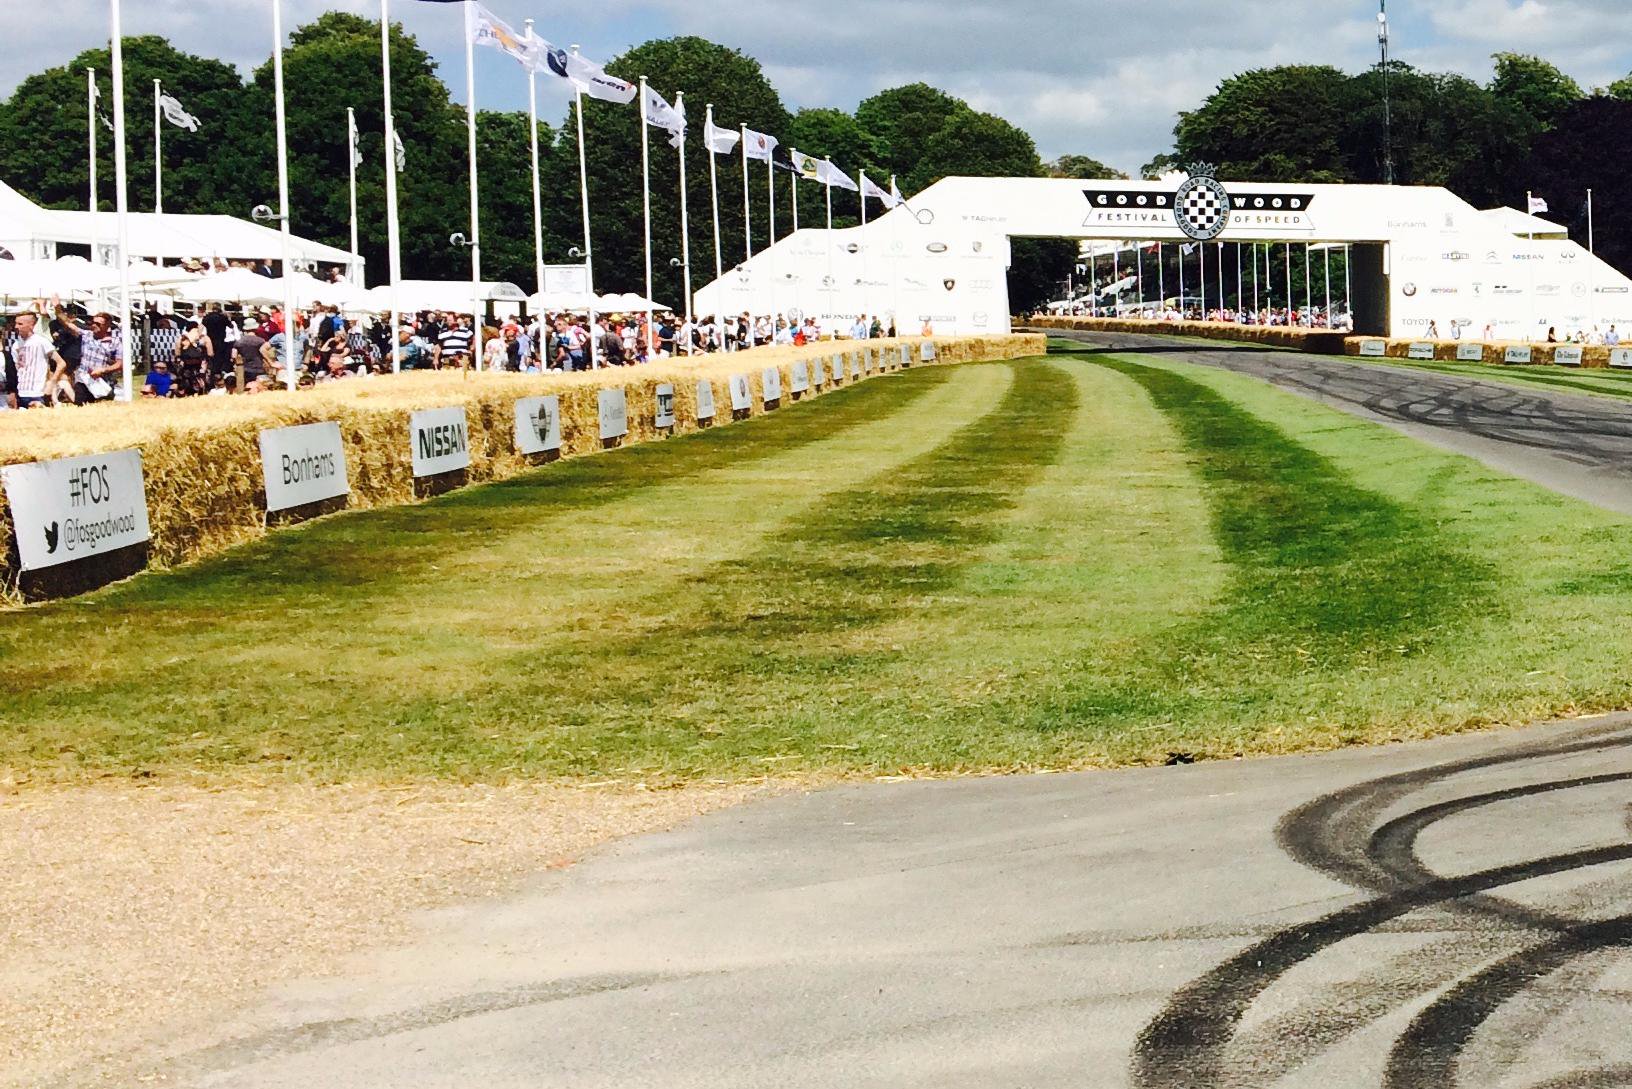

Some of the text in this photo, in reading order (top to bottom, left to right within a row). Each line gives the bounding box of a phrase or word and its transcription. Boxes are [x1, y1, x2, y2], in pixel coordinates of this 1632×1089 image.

[1096, 194, 1301, 209] GOOD WOOD
[1097, 212, 1300, 225] FESTIVAL OF SPEED
[418, 423, 466, 460] NISSAN
[282, 447, 335, 485] Bonhams
[69, 464, 110, 507] #FOS
[63, 506, 135, 551] @fosgoodwood
